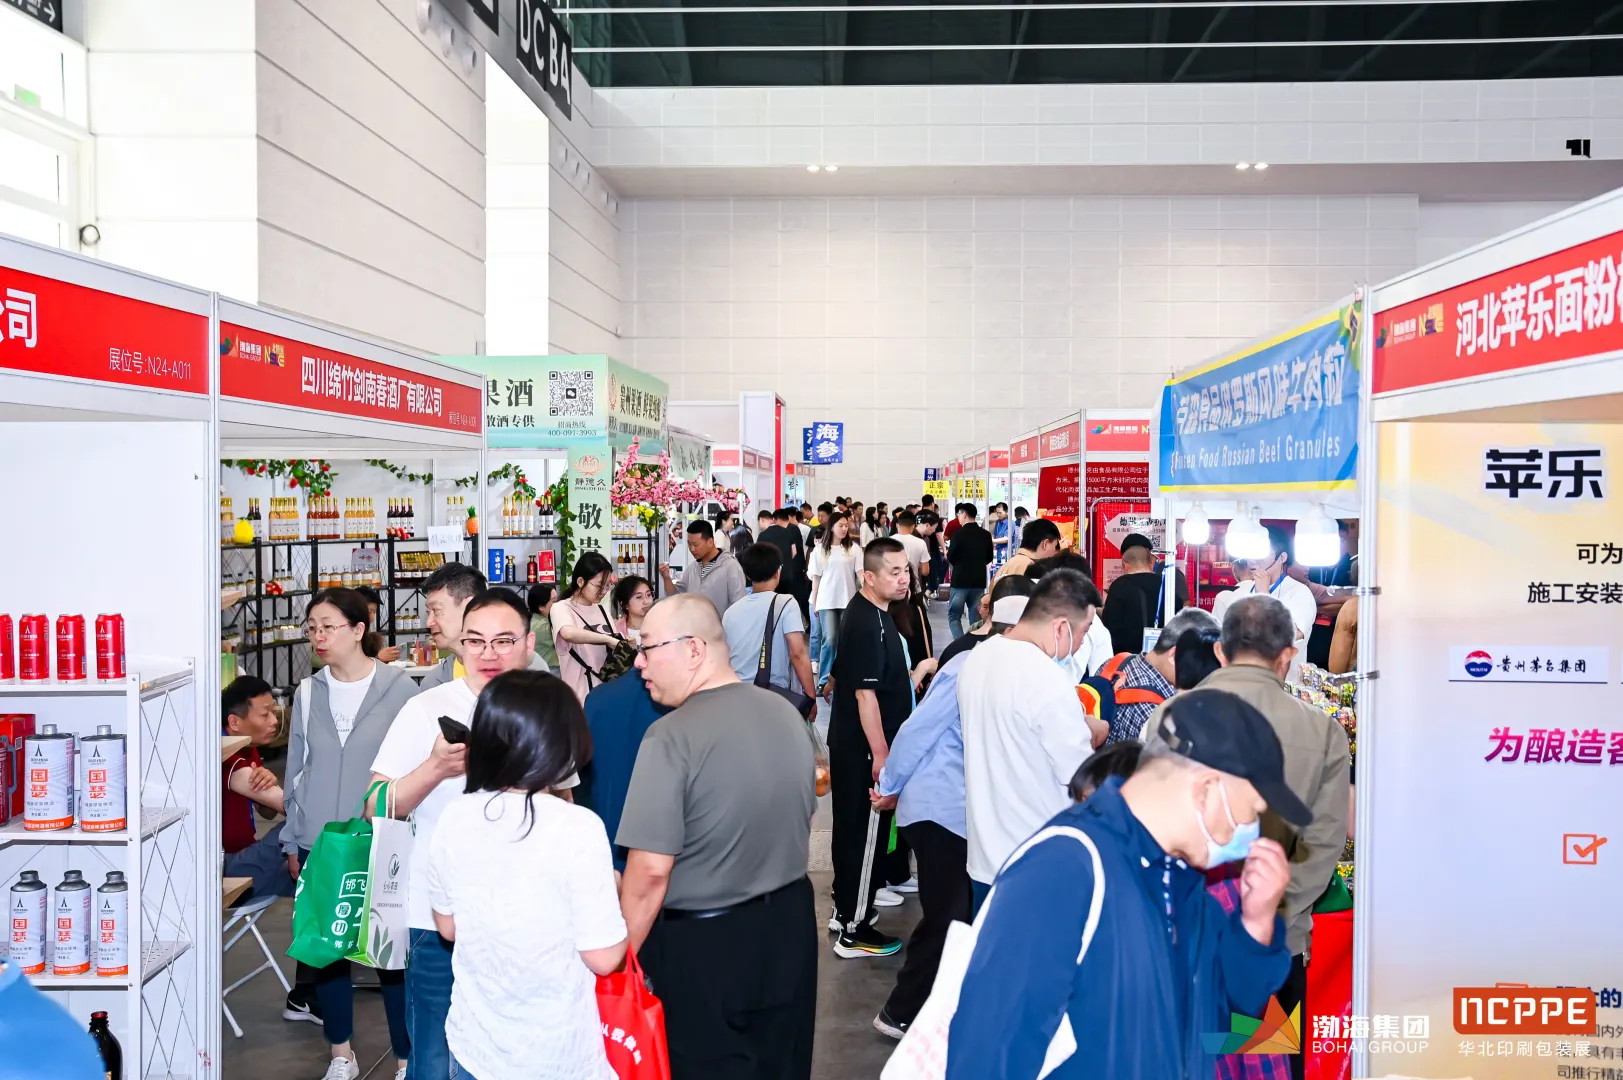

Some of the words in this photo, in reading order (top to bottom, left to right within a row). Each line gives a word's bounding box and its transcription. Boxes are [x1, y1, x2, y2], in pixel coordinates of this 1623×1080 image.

[0, 287, 37, 348] 司
[109, 347, 192, 380] 展位号:N24-A011
[301, 355, 443, 417] 四川绵竹剑南春酒厂有限公司
[547, 429, 597, 437] 400-091-3993
[557, 420, 587, 428] 招商热线
[816, 424, 839, 458] 海参
[1200, 448, 1219, 468] Food
[1222, 444, 1255, 467] Russian
[1259, 436, 1281, 464] Beef
[1286, 432, 1340, 462] Granules
[1485, 449, 1604, 498] 苹乐
[1576, 542, 1623, 564] 可为
[1527, 582, 1623, 604] 施工安装
[1497, 655, 1586, 673] 贵州茅台集团
